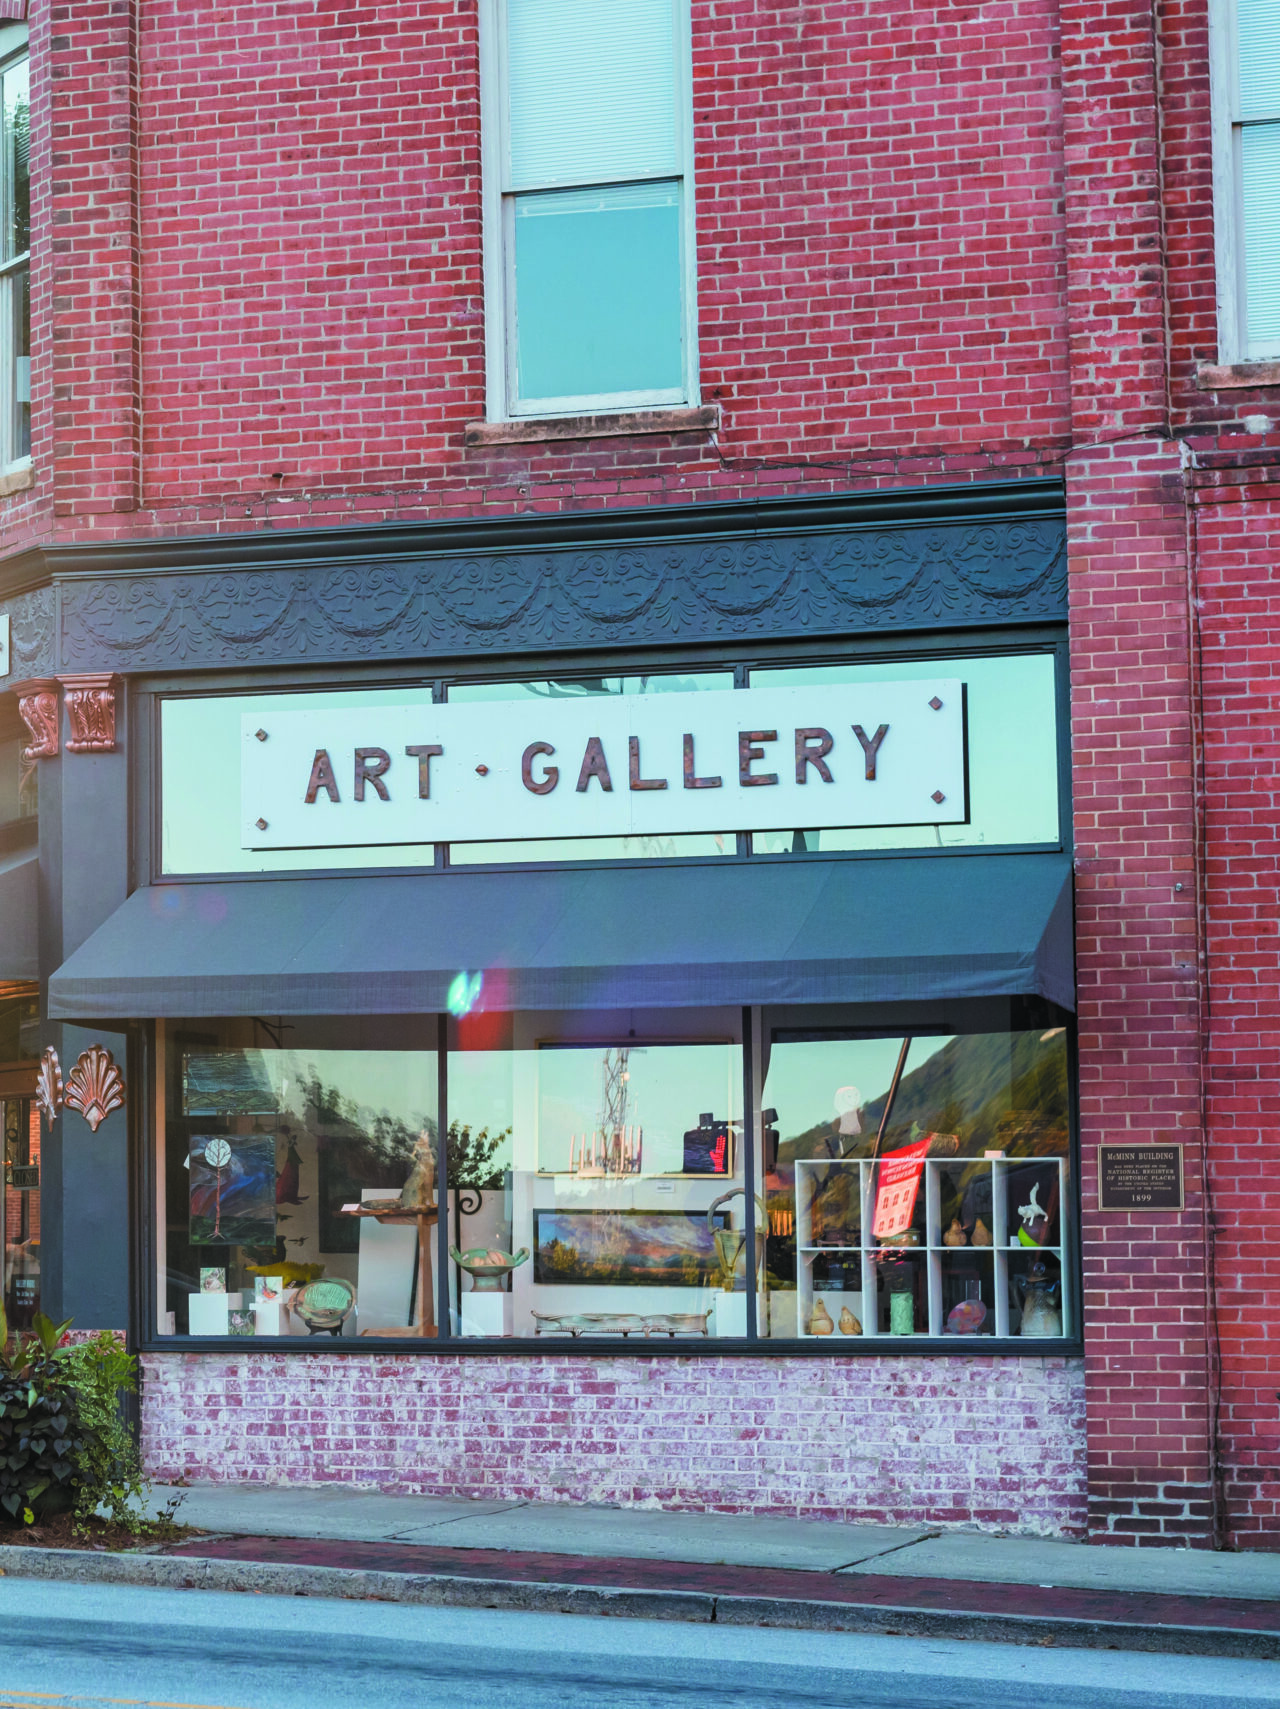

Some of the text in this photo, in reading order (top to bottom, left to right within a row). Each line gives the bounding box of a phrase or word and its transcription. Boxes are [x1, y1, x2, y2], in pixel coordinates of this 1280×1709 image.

[303, 723, 890, 804] ART GALLERY
[1107, 1152, 1174, 1161] McMINN BUILDING
[14, 1169, 38, 1186] CLOSED
[1131, 1194, 1152, 1202] 1899
